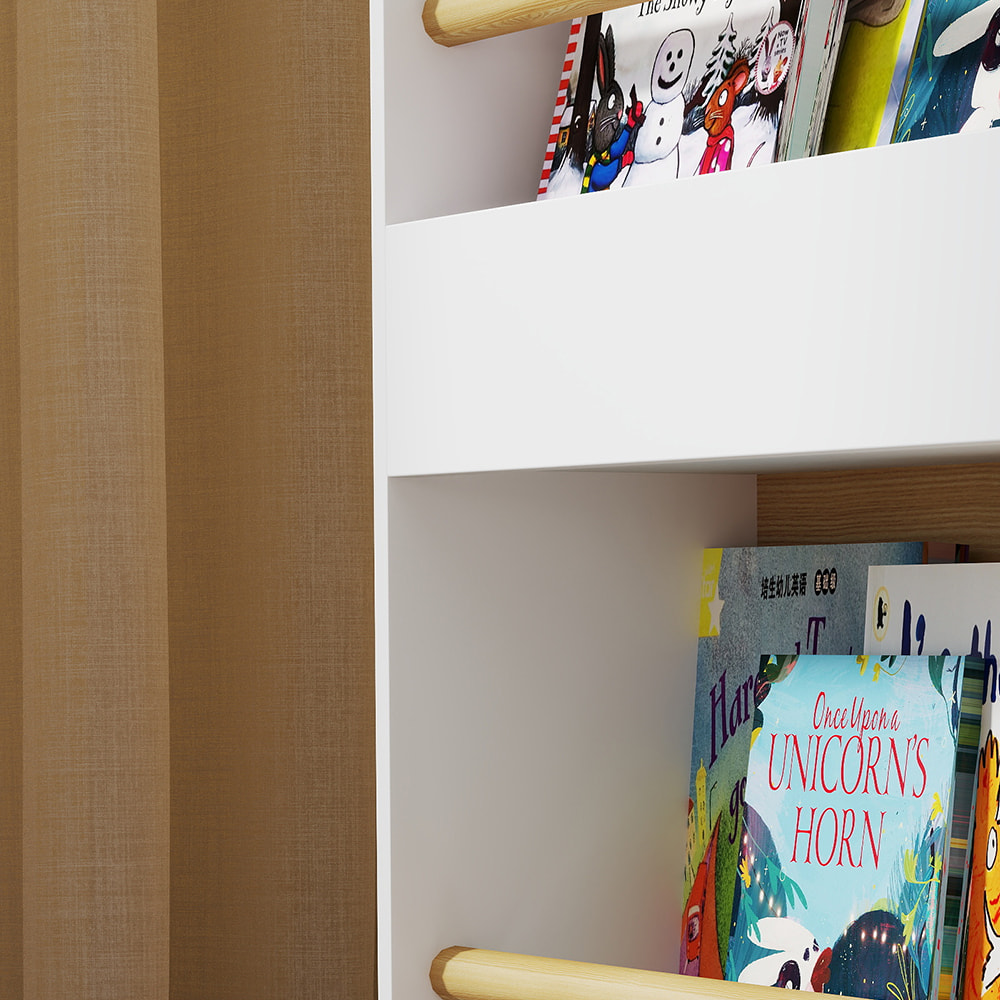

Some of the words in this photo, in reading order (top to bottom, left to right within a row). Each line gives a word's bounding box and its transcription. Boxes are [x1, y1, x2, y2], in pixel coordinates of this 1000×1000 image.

[777, 30, 789, 39] Now
[780, 37, 788, 48] TV
[760, 572, 807, 600] 培生幼儿英语
[813, 691, 849, 730] Once
[850, 696, 889, 754] Upon
[890, 709, 901, 732] a
[790, 806, 887, 870] HORN
